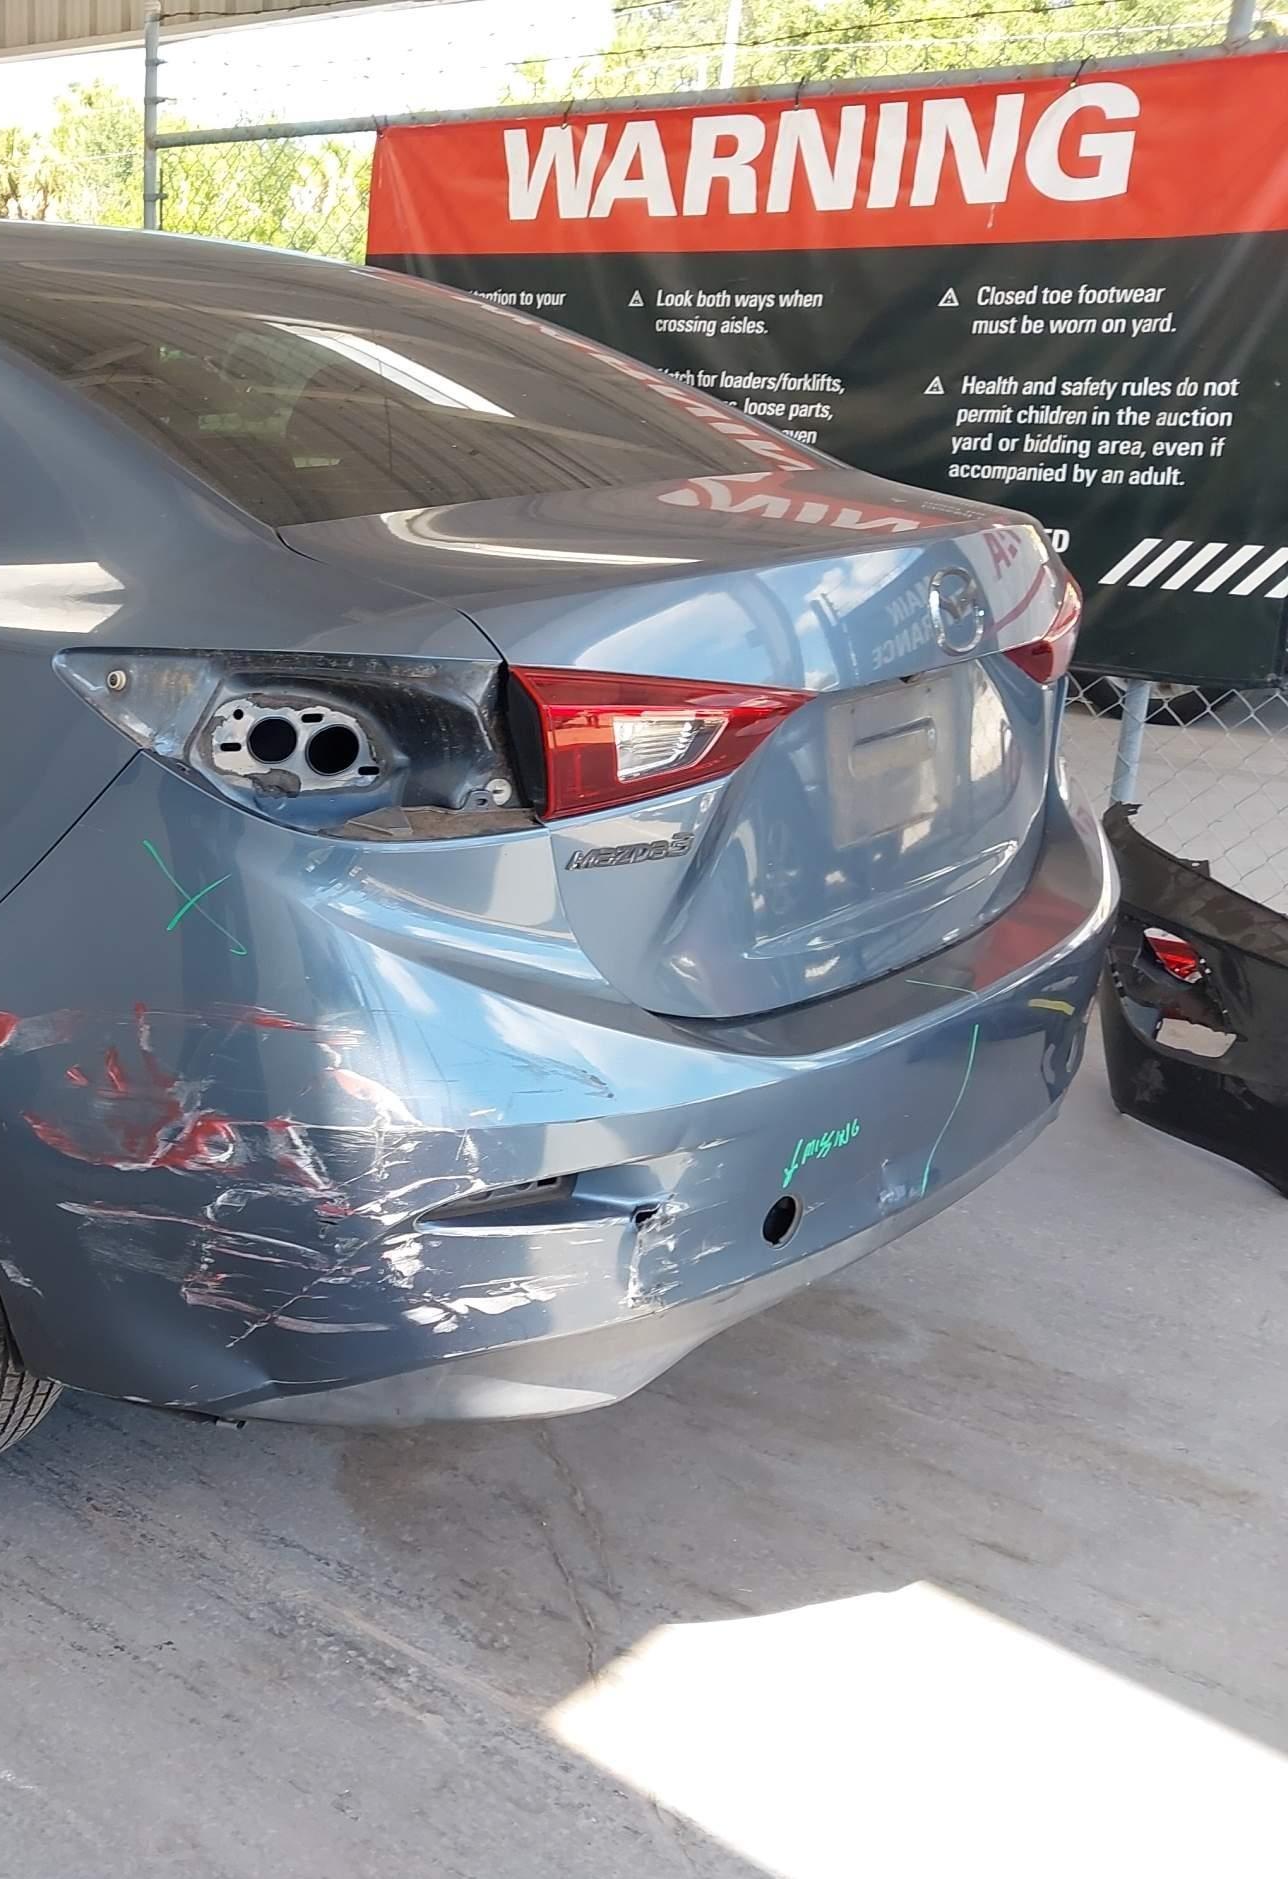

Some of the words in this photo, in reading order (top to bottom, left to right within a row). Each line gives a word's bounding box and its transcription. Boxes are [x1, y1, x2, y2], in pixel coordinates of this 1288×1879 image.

[503, 81, 1141, 221] WARNING
[519, 290, 534, 306] to
[535, 292, 567, 310] your
[656, 289, 693, 309] Look
[696, 288, 731, 309] both
[734, 292, 775, 311] ways
[778, 290, 823, 309] when
[977, 285, 1039, 306] Closed
[1042, 289, 1073, 305] toe
[1077, 284, 1166, 305] footwear
[655, 316, 717, 335] crossing
[720, 316, 769, 335] aisles.
[971, 316, 1017, 335] must
[1020, 314, 1045, 334] be
[1048, 318, 1097, 334] worn
[1101, 318, 1127, 334] on
[1130, 312, 1177, 338] yard.
[697, 369, 718, 388] for
[719, 370, 846, 395] loaders/forklifts,
[961, 375, 1019, 396] Health
[1021, 376, 1058, 396] and
[1060, 377, 1117, 400] safety
[1120, 376, 1172, 397] rules
[1175, 377, 1199, 397] do
[1202, 378, 1241, 397] not
[743, 397, 786, 417] loose
[788, 402, 834, 421] parts,
[955, 405, 1013, 427] permit
[1016, 405, 1088, 426] children
[1090, 406, 1110, 426] in
[1115, 407, 1151, 427] the
[1155, 407, 1234, 427] auction
[951, 433, 993, 455] yard
[997, 437, 1020, 452] or
[1023, 434, 1091, 459] bidding
[1097, 438, 1147, 459] area,
[1152, 440, 1204, 457] even
[1209, 437, 1225, 457] if
[948, 464, 1067, 485] accompanied
[1072, 464, 1098, 488] by
[1101, 470, 1125, 485] an
[1128, 466, 1185, 486] adult.
